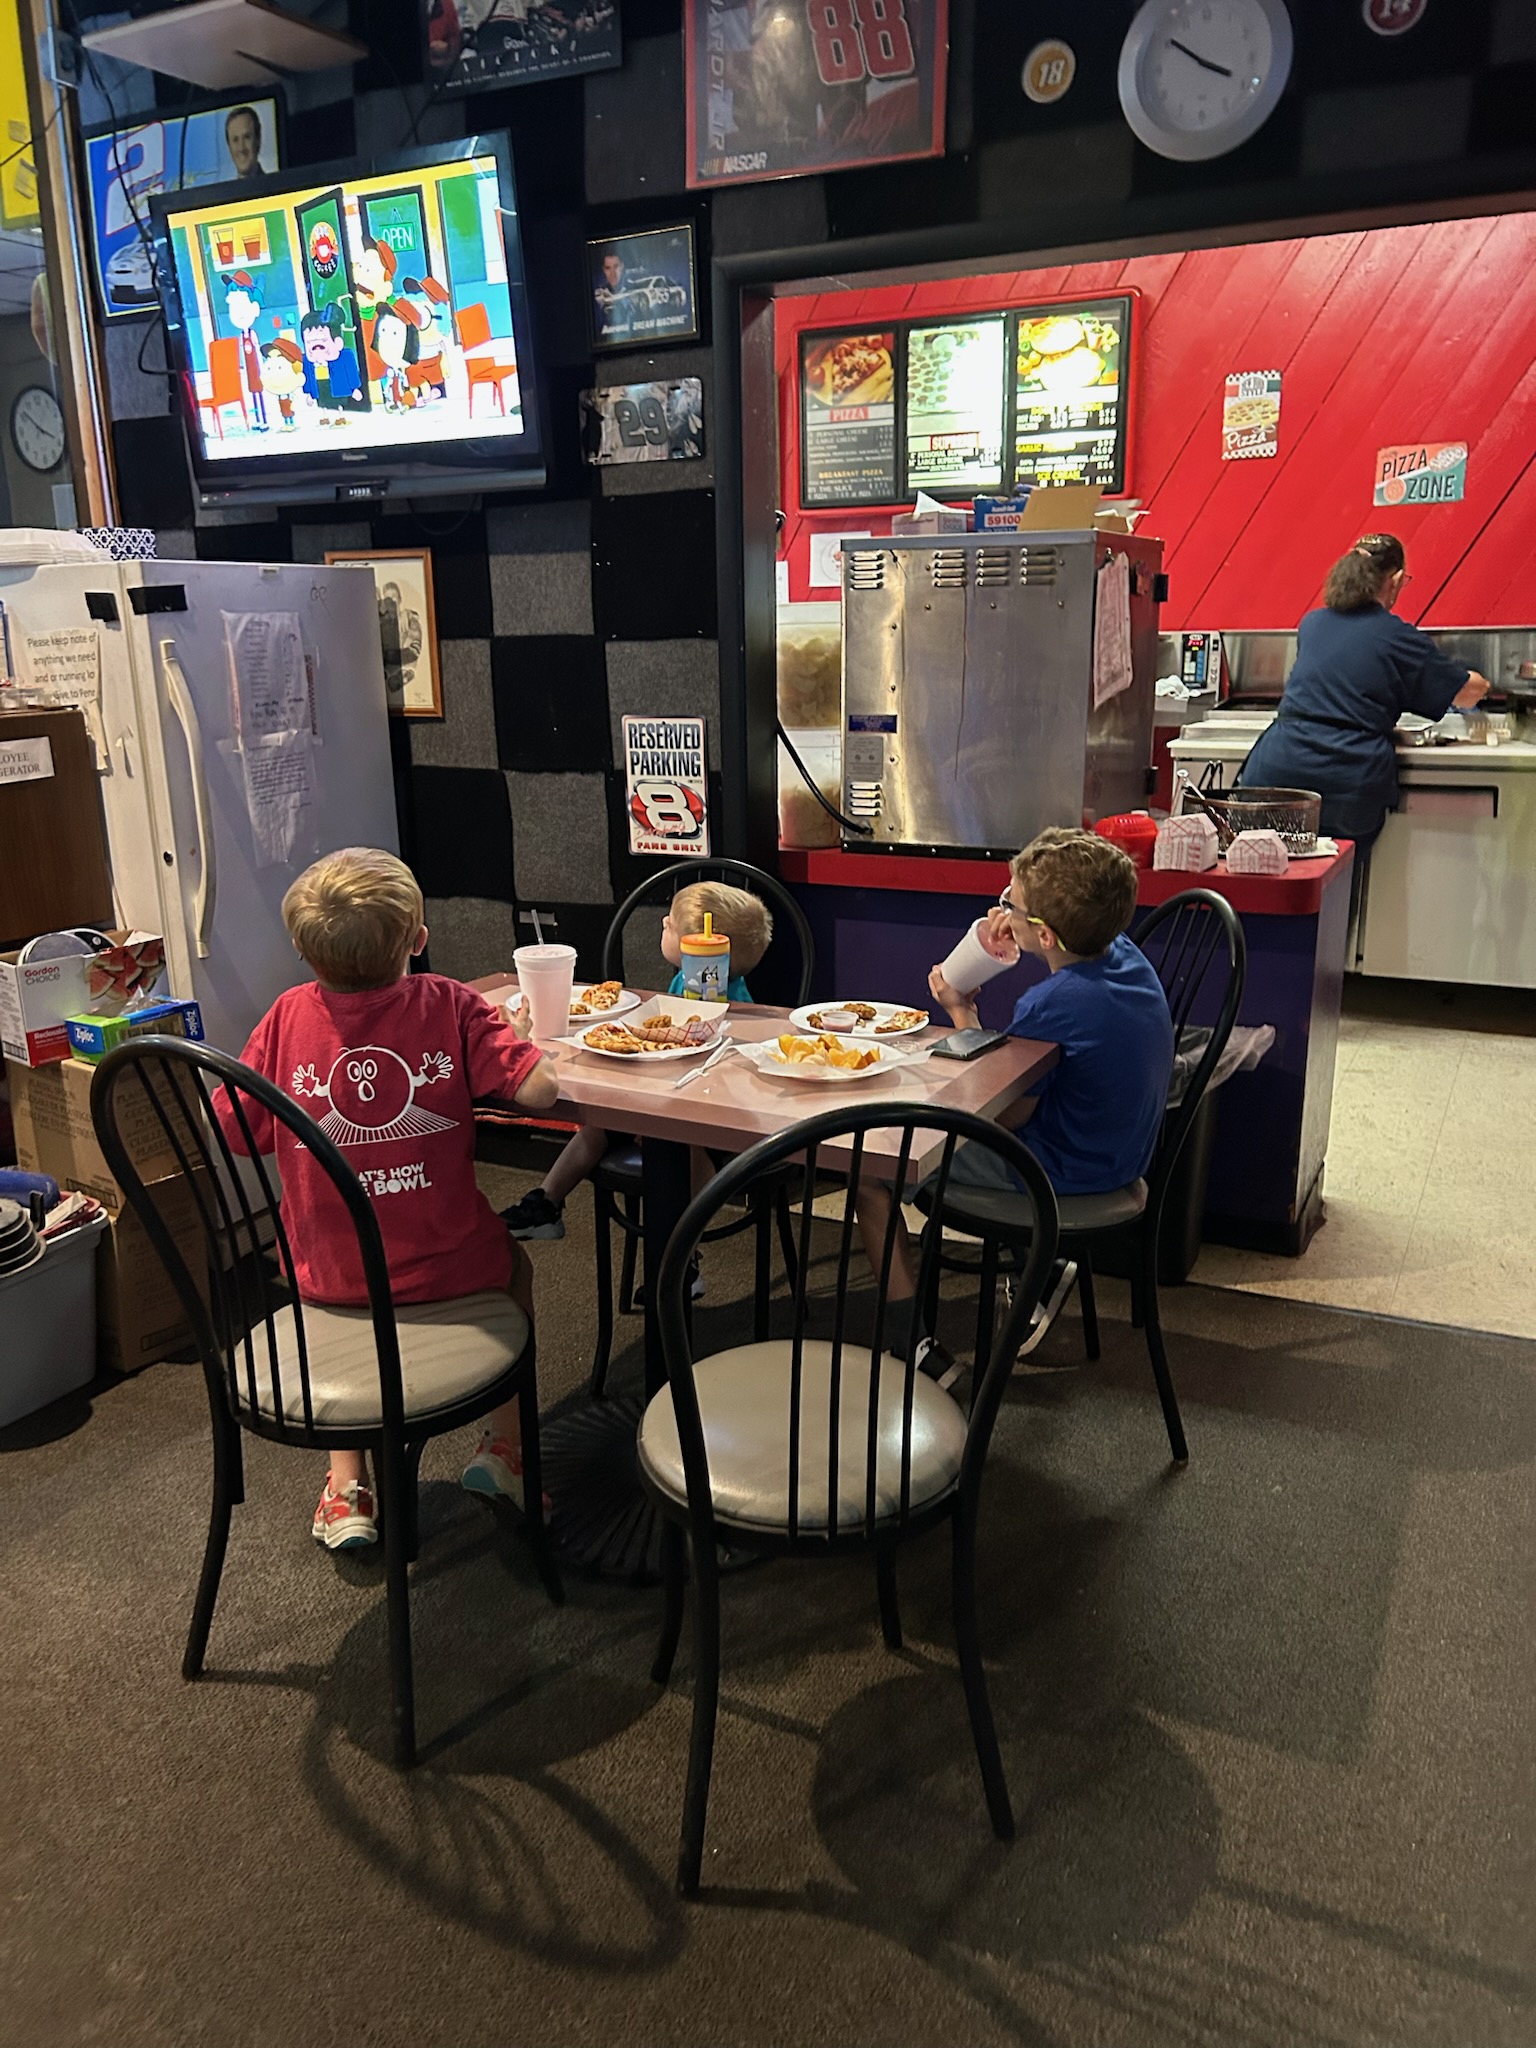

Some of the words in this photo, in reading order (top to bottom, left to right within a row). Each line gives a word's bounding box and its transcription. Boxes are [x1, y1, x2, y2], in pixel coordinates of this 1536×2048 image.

[806, 0, 916, 86] 88
[1037, 60, 1066, 88] 18
[723, 152, 768, 173] NASCAR
[106, 121, 165, 236] 2
[382, 224, 415, 252] OPEN
[614, 397, 669, 447] 29
[833, 407, 865, 421] PIZZA
[1225, 431, 1267, 450] Pizza
[1382, 447, 1428, 482] PIZZA
[1407, 474, 1455, 500] ZONE
[986, 514, 1021, 526] 59100
[27, 637, 50, 648] Please
[50, 635, 69, 648] keep
[70, 633, 87, 644] note
[88, 631, 97, 643] of
[33, 653, 65, 667] anything
[77, 651, 97, 662] need
[34, 672, 49, 683] and
[627, 722, 701, 750] RESERVED
[629, 750, 702, 778] PARKING
[635, 781, 699, 838] 8
[672, 843, 703, 852] ONLY
[24, 965, 60, 978] Gordon
[185, 1008, 199, 1037] Ziploc
[74, 1026, 95, 1044] Ziploc
[358, 1168, 387, 1183] AT'S
[389, 1161, 425, 1180] HOW
[373, 1172, 433, 1196] BOWL
